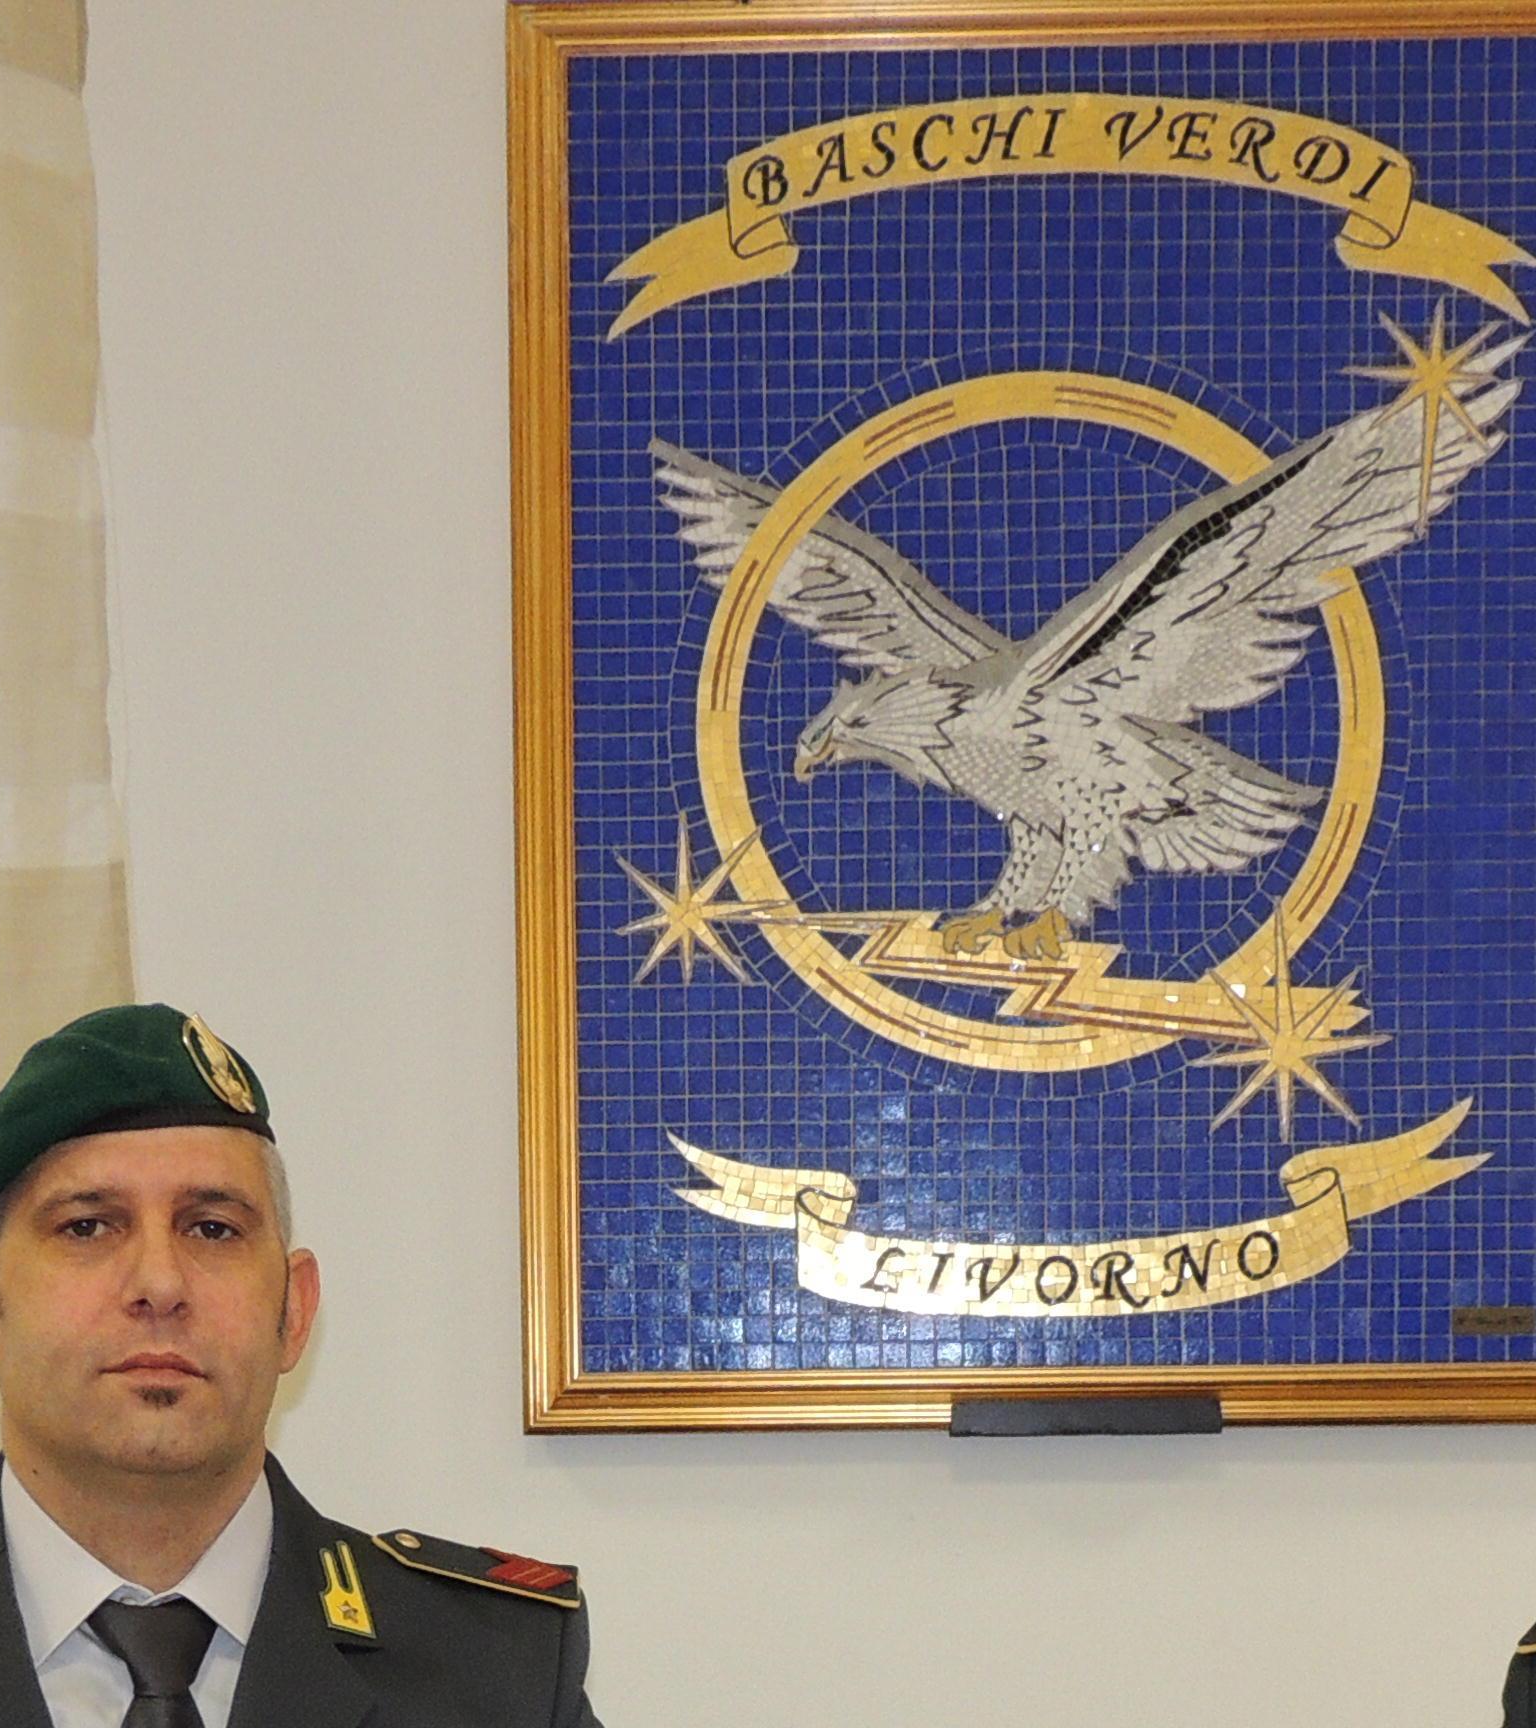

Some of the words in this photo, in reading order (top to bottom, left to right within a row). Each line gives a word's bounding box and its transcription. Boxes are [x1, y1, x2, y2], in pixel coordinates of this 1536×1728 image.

[742, 105, 1066, 207] BASCHI
[1104, 105, 1400, 203] VERDI
[860, 1230, 1280, 1308] LIVORNO
